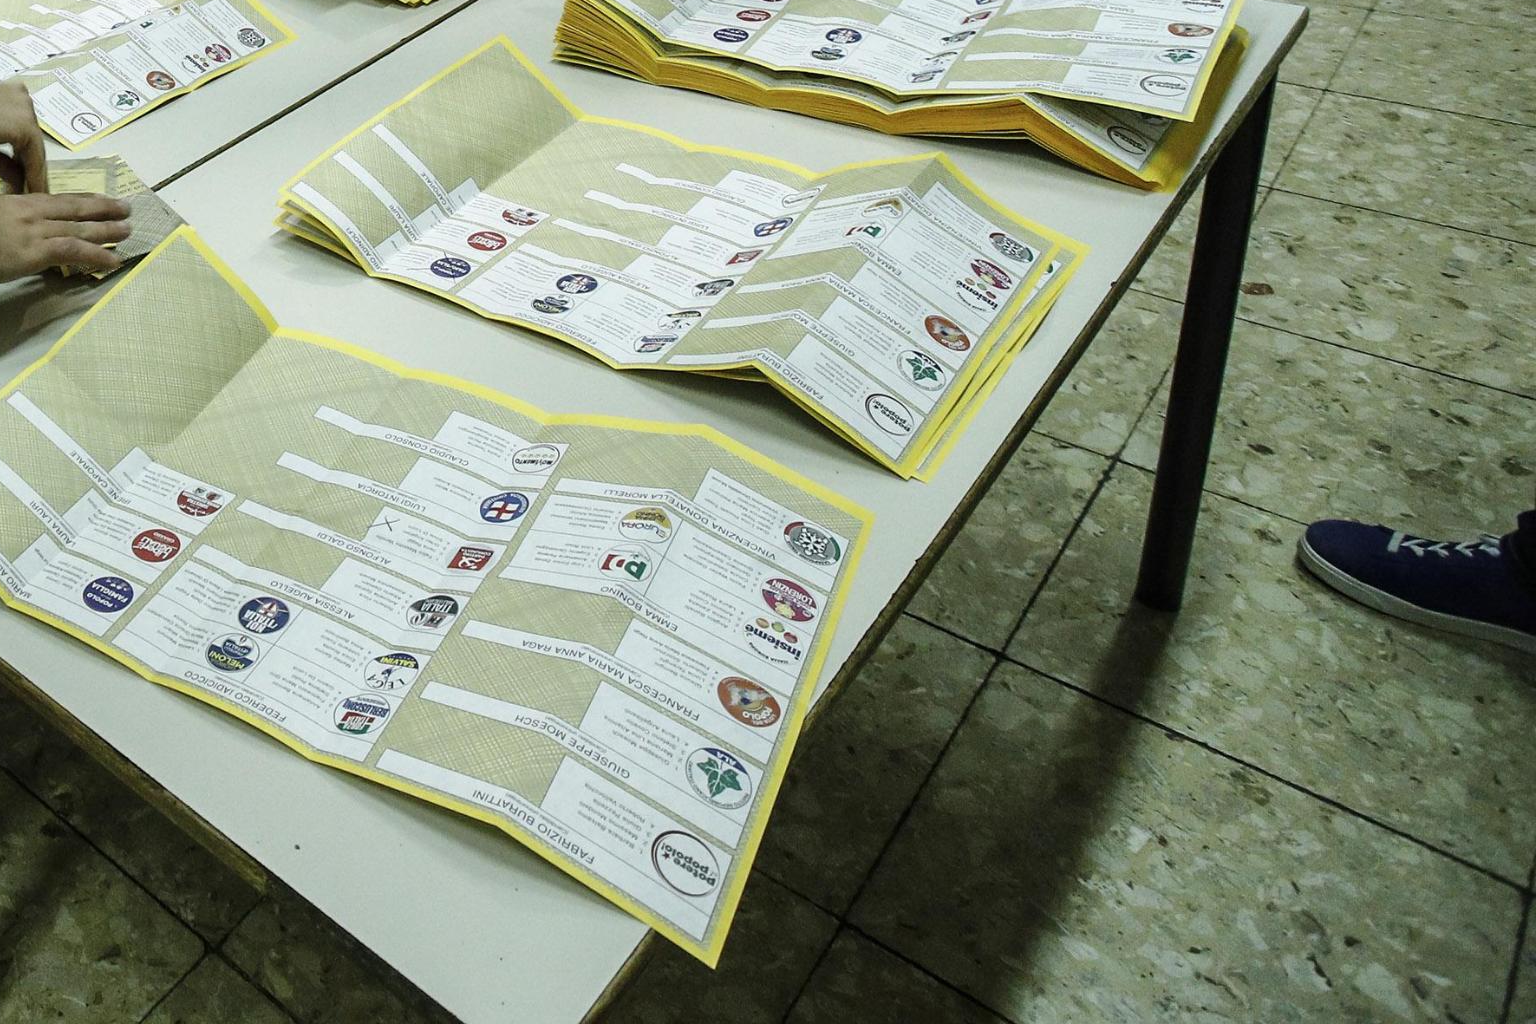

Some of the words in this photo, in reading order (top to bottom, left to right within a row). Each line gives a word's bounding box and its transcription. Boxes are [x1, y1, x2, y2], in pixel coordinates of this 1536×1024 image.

[384, 432, 427, 451] CONSOLO
[428, 443, 469, 466] CLAUDIO
[514, 457, 552, 465] MOVIMENTO
[68, 449, 108, 490] CAPORALE
[355, 482, 399, 502] INTORCIA
[398, 496, 425, 512] LUIGI
[603, 486, 648, 498] MORELLI
[28, 500, 51, 525] LAURI
[649, 492, 709, 525] DONATELLA
[315, 530, 347, 548] GALDI
[621, 520, 666, 538] EUROPA
[708, 520, 777, 561] VINCENZINA
[347, 542, 391, 565] ALFONSO
[89, 581, 128, 603] FAMIGLIA
[269, 579, 314, 601] AUGELLO
[600, 585, 643, 611] BONINO
[770, 578, 813, 606] LORENZIN
[313, 597, 355, 619] ALESSIA
[642, 607, 678, 632] EMMA
[521, 638, 552, 651] RAGA
[554, 644, 585, 659] ANNA
[742, 622, 802, 661] insieme
[208, 649, 245, 669] MELONI
[378, 654, 416, 668] SALVINI
[586, 653, 625, 679] MARIA
[183, 668, 235, 695] IADICICCO
[233, 691, 287, 723] FEDERICO
[625, 674, 700, 721] FRANCESCA
[513, 712, 567, 741] MOESCH
[567, 736, 631, 780] GIUSEPPE
[714, 750, 737, 767] ALA
[470, 787, 535, 826] BURATTINI
[535, 821, 595, 864] FABRIZIO
[658, 841, 710, 875] popolo!
[671, 854, 718, 888] potere
